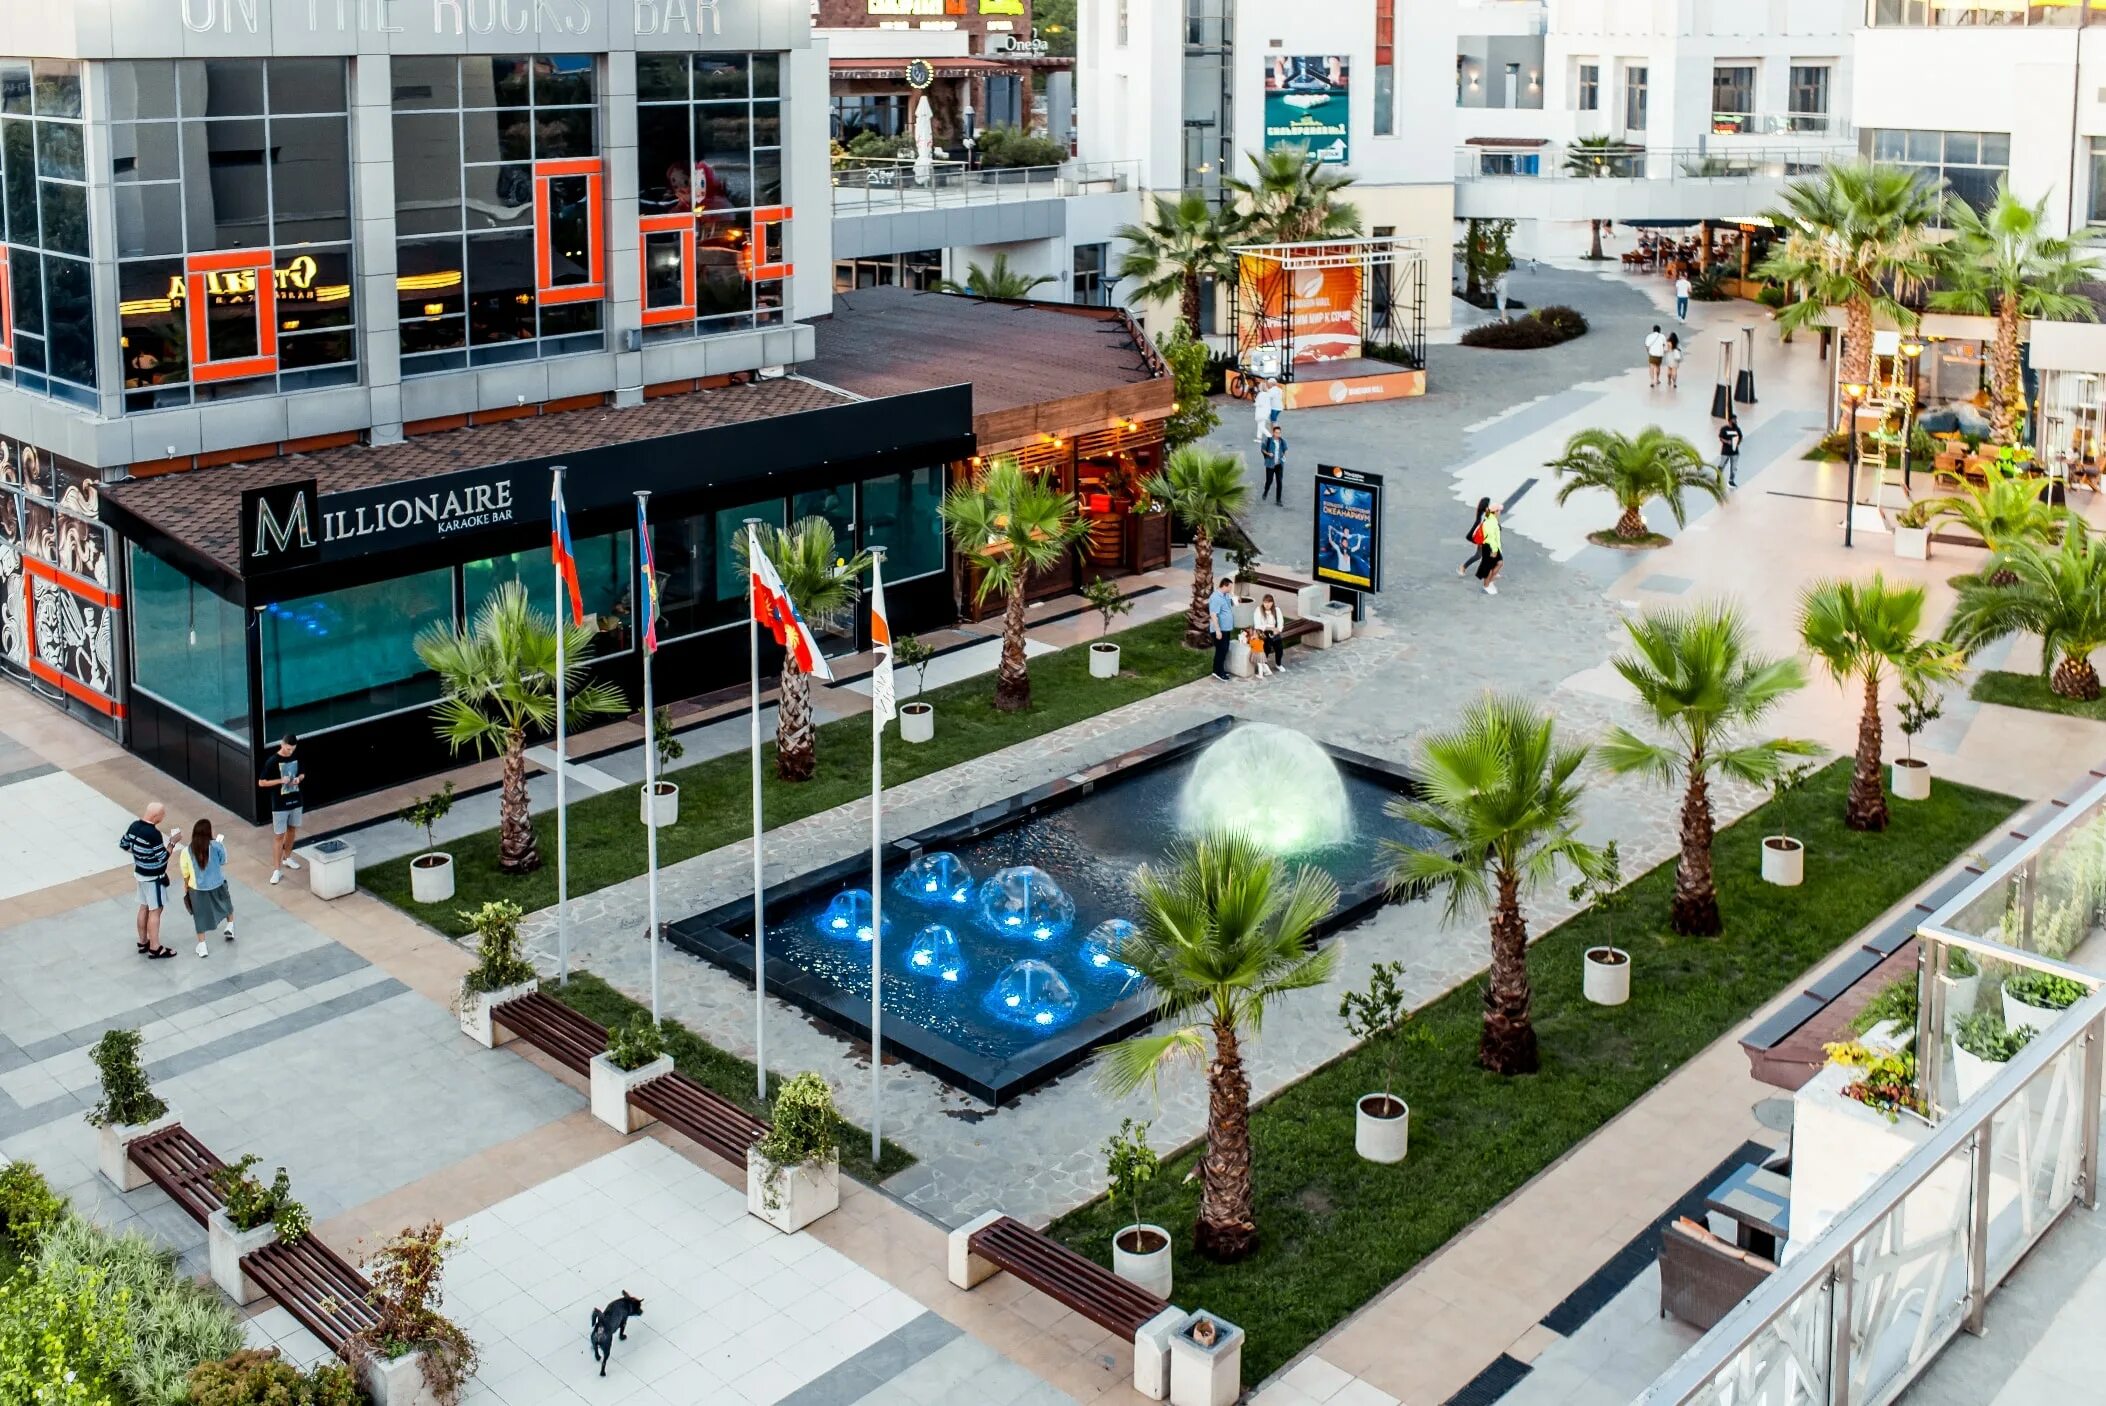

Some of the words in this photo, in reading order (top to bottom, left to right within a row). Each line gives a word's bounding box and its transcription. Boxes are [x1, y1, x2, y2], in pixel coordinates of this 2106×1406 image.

[634, 0, 720, 35] BAR
[252, 480, 513, 556] MILLIONAIRE
[438, 514, 490, 533] KARAOKE
[492, 508, 513, 523] BAR
